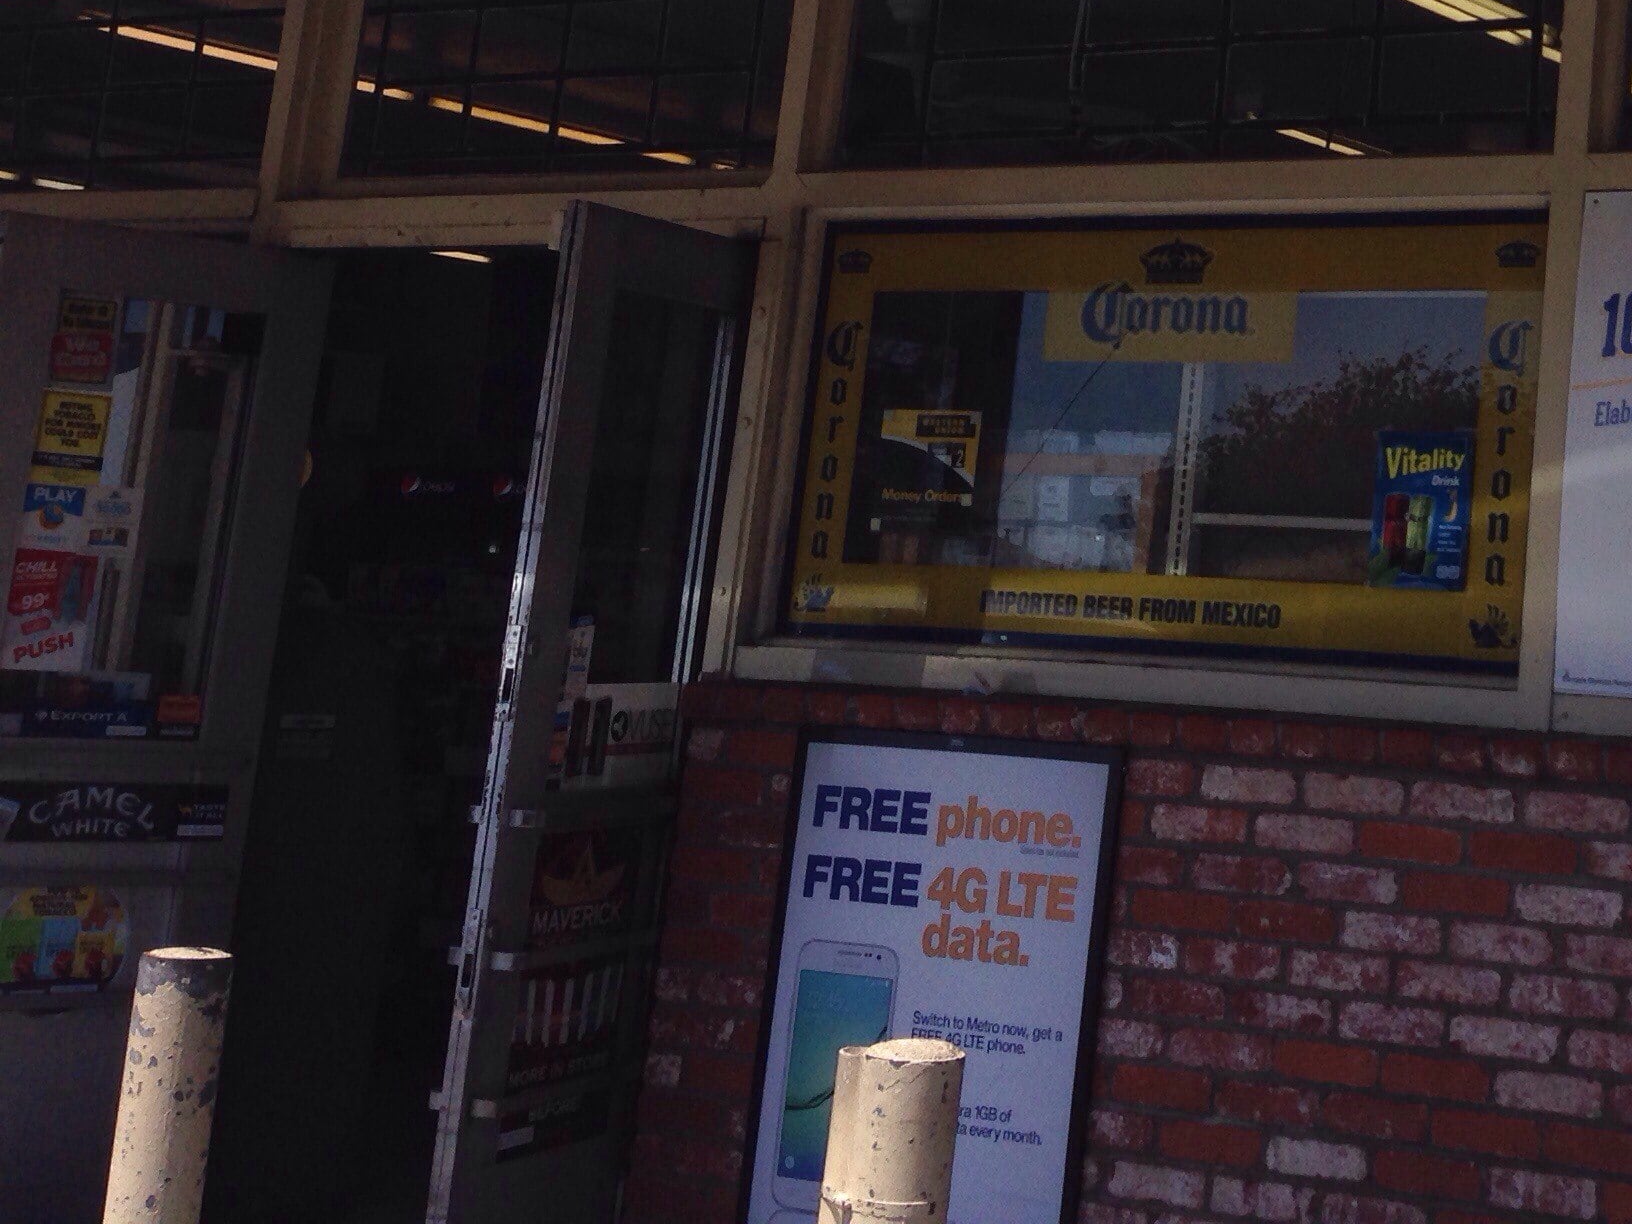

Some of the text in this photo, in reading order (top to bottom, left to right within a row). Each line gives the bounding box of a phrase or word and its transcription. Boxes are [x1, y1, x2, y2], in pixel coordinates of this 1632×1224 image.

[1081, 280, 1248, 349] Corona
[811, 320, 864, 559] Corona
[1485, 320, 1534, 587] Corona
[1385, 446, 1466, 479] Vitality
[34, 485, 79, 502] PLAY
[881, 488, 922, 504] Money
[979, 589, 1281, 629] IMPORTED BEER FROM MEXICO
[13, 631, 74, 663] PUSH
[29, 785, 155, 830] CAMEL
[812, 784, 1082, 848] FREE phone.
[49, 817, 129, 839] WHITE
[802, 854, 1078, 923] FREE 4G LTE
[533, 900, 623, 932] MAVERICK
[921, 914, 1029, 967] data.
[913, 1010, 1063, 1043] Switch to Metro now, get a
[964, 1034, 985, 1051] LTE
[987, 1038, 1026, 1055] phone.
[975, 1105, 998, 1122] 1GB
[999, 1109, 1013, 1123] of
[969, 1125, 1001, 1143] every
[1003, 1128, 1043, 1147] month.
